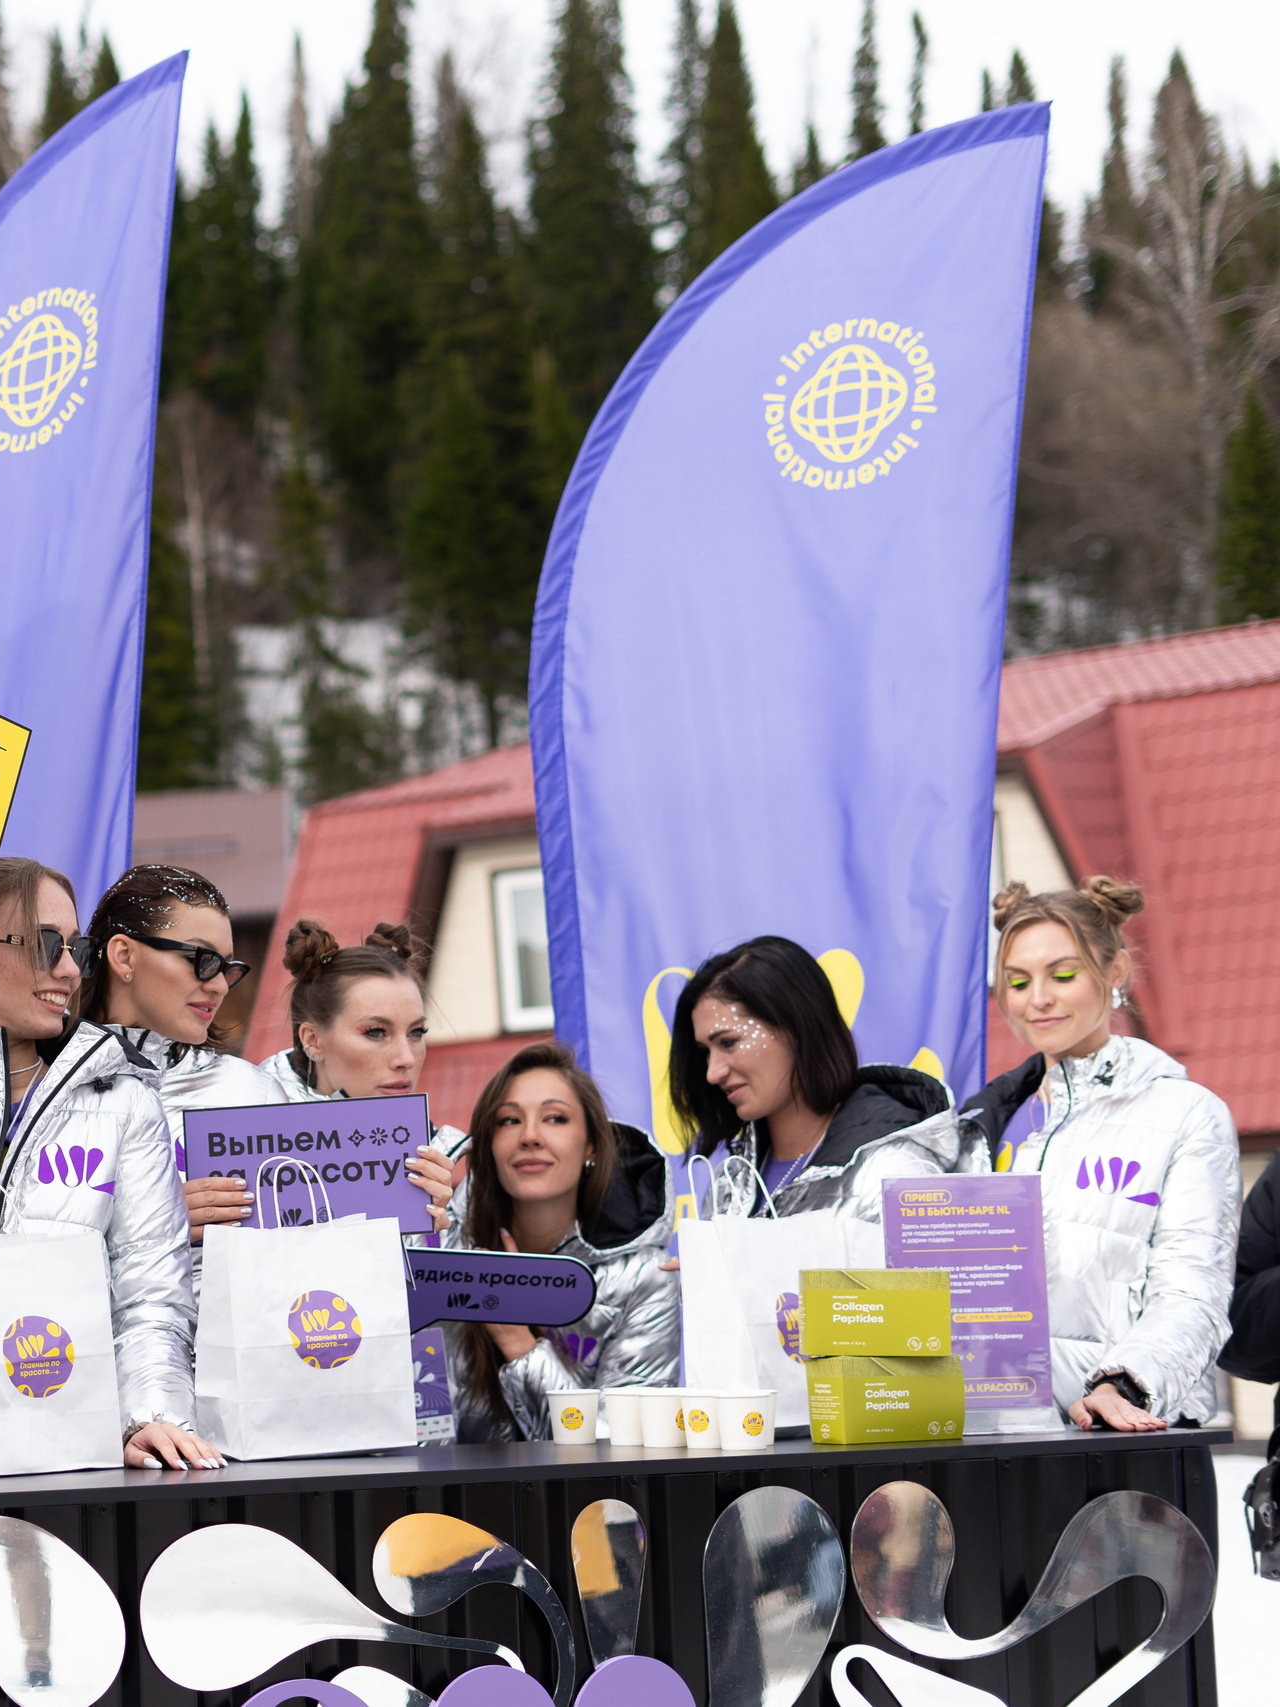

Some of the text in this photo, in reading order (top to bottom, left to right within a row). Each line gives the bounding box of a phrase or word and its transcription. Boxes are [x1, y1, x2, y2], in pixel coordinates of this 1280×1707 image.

[779, 318, 938, 413] international
[762, 393, 920, 491] international
[208, 1129, 341, 1157] Выпьем
[904, 1192, 947, 1204] ПРИВЕТ,
[900, 1205, 1010, 1217] ТЫ В БЬЮТИ-БАРЕ NL
[414, 1269, 577, 1289] ядись красотой
[832, 1302, 884, 1313] Collagen
[832, 1314, 884, 1325] Peptides
[305, 1334, 337, 1342] Главные
[307, 1341, 338, 1350] красоте
[20, 1362, 50, 1370] Главные
[20, 1369, 50, 1378] красоте
[976, 1382, 1028, 1393] КРАСОТУ!
[865, 1388, 910, 1400] Collagen
[865, 1400, 910, 1412] Peptides
